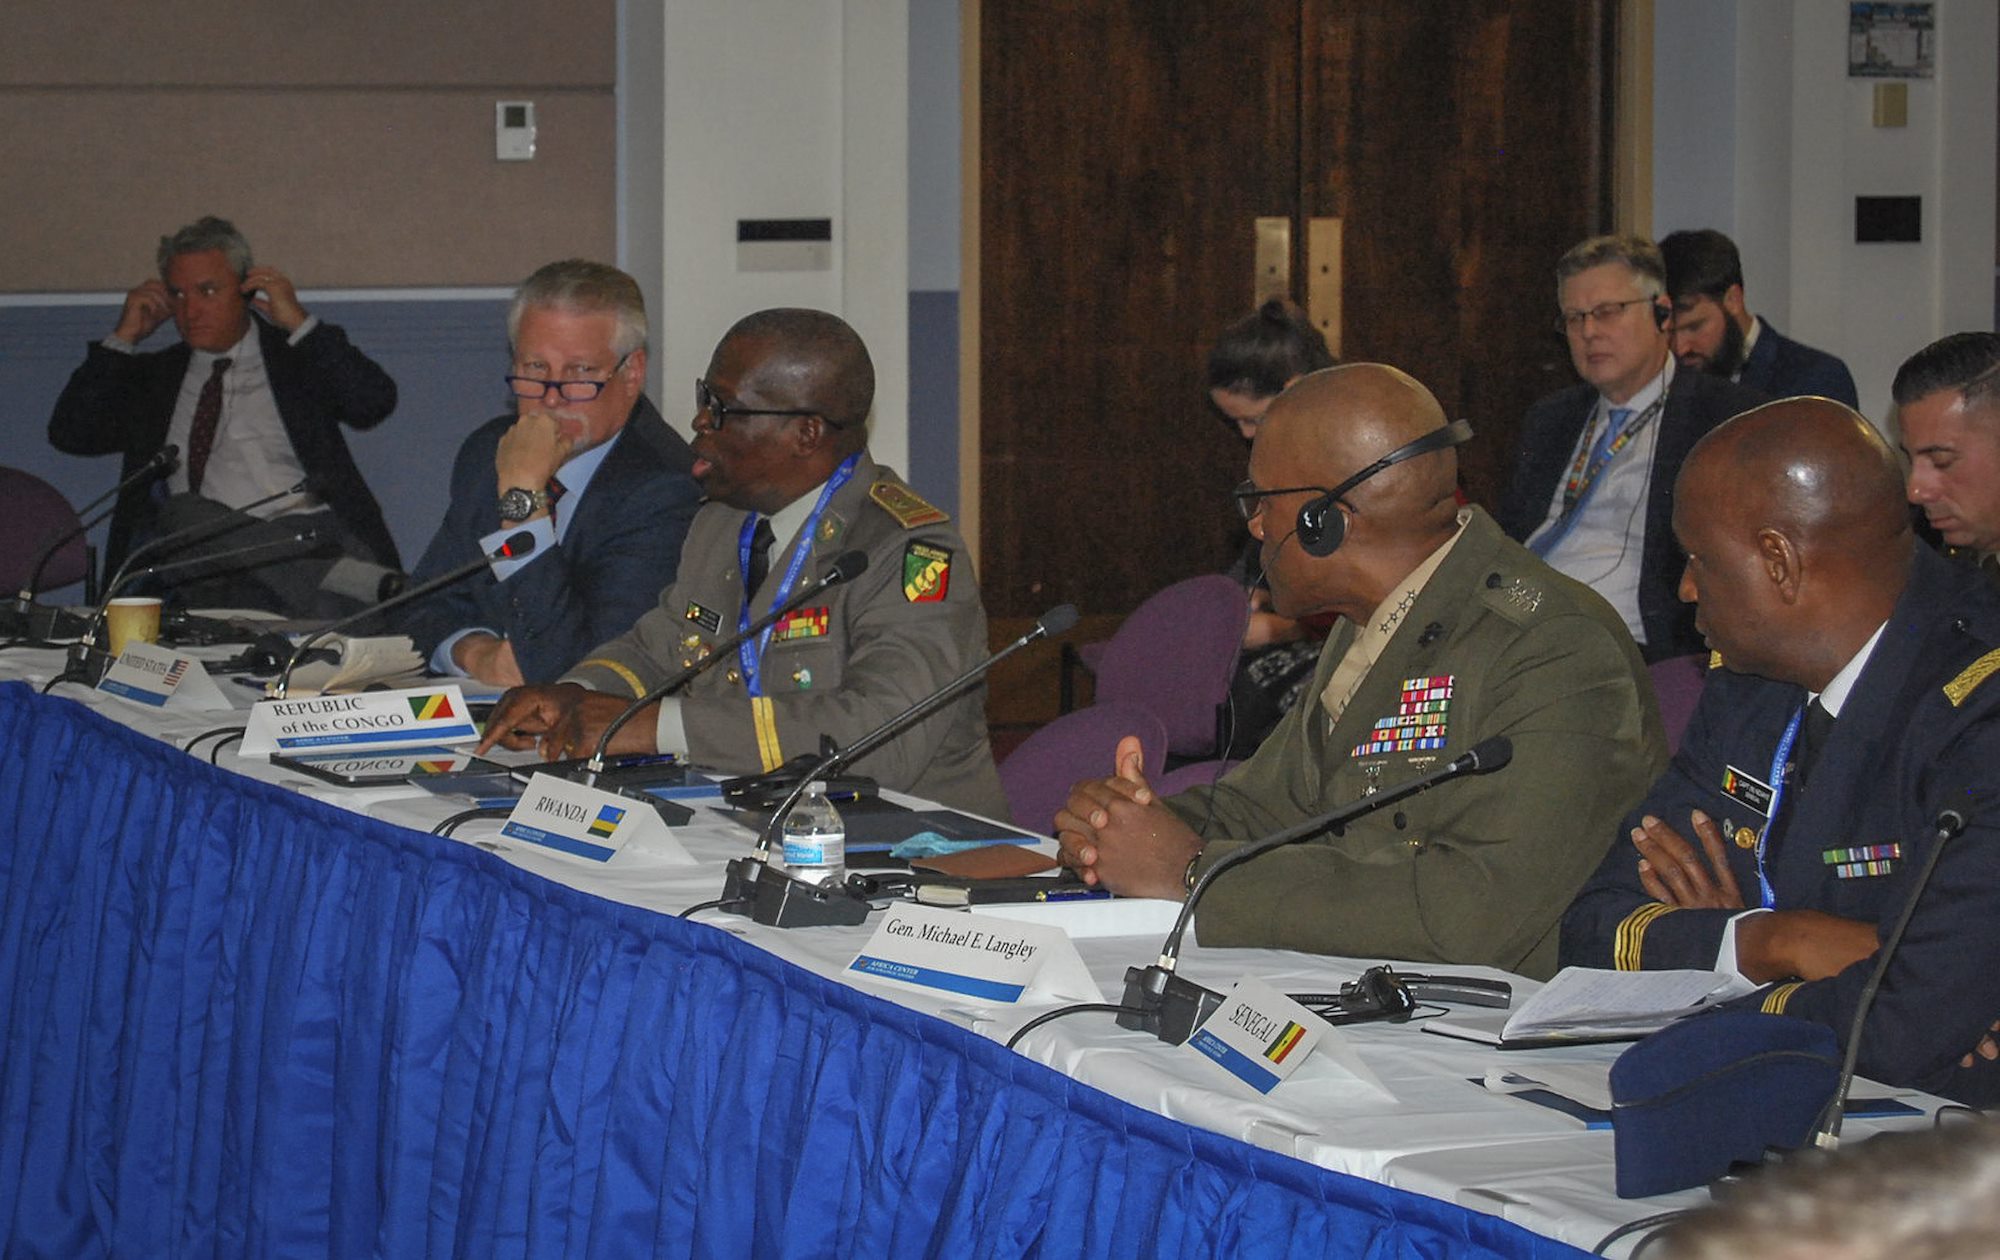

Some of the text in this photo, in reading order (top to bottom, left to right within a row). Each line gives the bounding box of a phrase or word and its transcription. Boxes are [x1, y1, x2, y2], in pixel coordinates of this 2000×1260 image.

[273, 697, 366, 716] REPUBLIC
[282, 714, 404, 734] of the CONGO
[535, 796, 588, 823] RWANDA
[886, 918, 1037, 962] Gen. Michael E. Langley
[1229, 1003, 1277, 1043] SENEGAL
